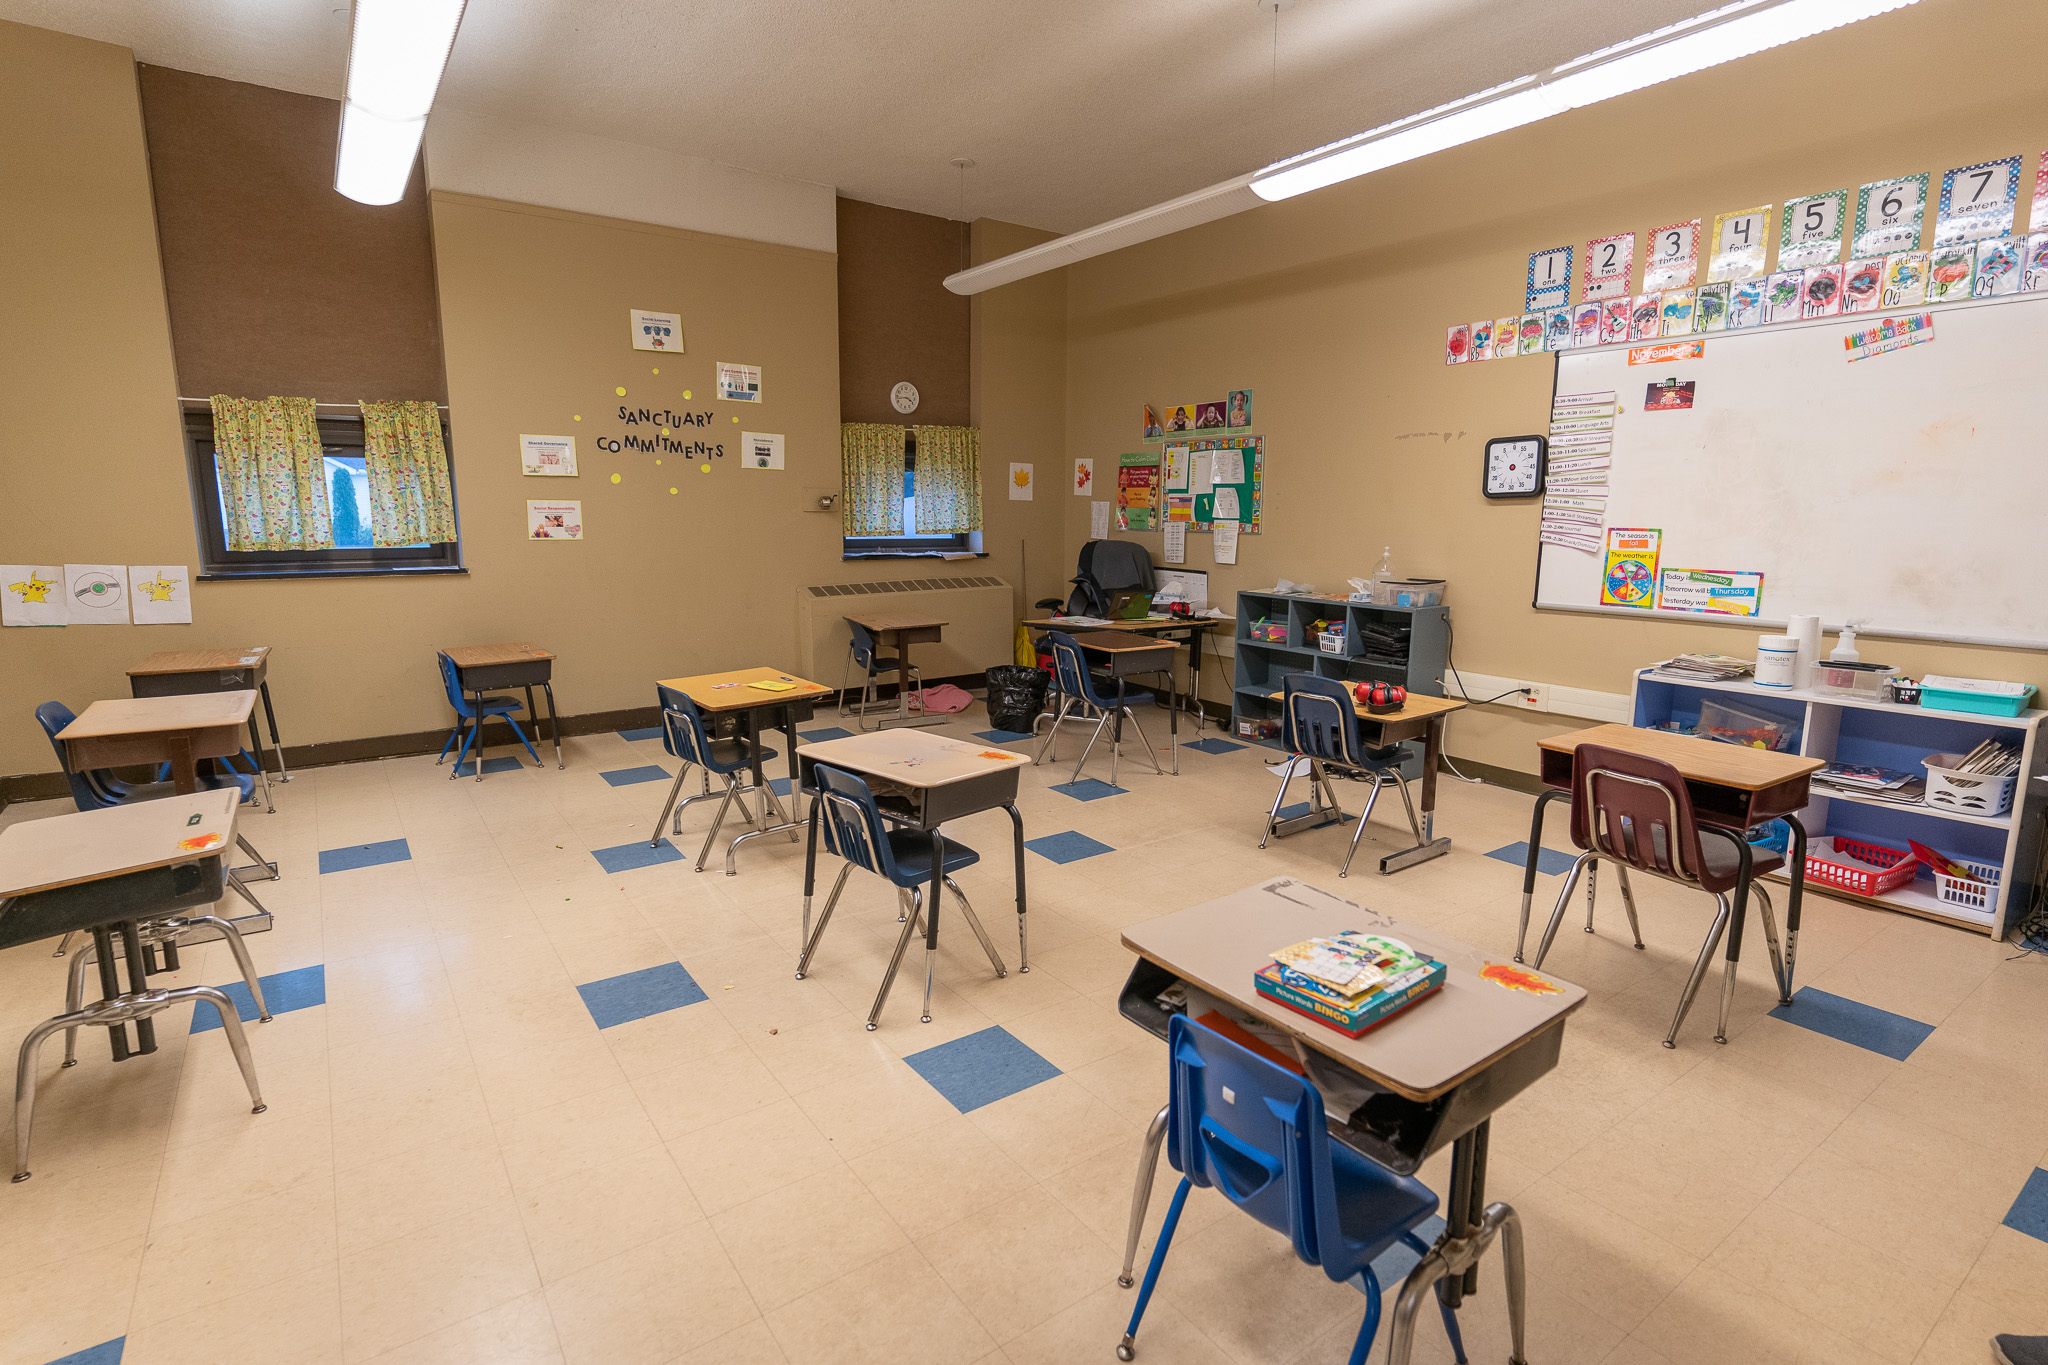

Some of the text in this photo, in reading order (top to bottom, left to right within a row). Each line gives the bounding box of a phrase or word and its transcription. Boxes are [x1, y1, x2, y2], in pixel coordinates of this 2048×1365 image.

[1969, 170, 1994, 203] 7
[1881, 186, 1903, 217] 6
[1957, 200, 1998, 214] seven
[1804, 201, 1826, 231] 5
[1881, 216, 1899, 226] six
[1733, 218, 1751, 244] 4
[1802, 230, 1824, 240] five
[1664, 231, 1681, 257] 3
[1728, 243, 1752, 253] four
[1602, 243, 1617, 268] 2
[1658, 254, 1686, 265] three
[1895, 253, 1929, 267] octopus
[1547, 256, 1553, 280] 1
[1600, 267, 1618, 275] two
[1865, 258, 1886, 271] nest
[1542, 278, 1557, 286] one
[1974, 275, 1995, 296] Qq
[2023, 270, 2041, 291] Rr
[1701, 283, 1729, 295] jellyfish
[1930, 281, 1948, 301] Pp
[1841, 294, 1859, 313] Nn
[1883, 288, 1901, 307] Oo
[1802, 300, 1825, 317] Mm
[1630, 322, 1642, 340] Hh
[1661, 320, 1670, 336] Ii
[1862, 333, 1919, 356] Diamonds
[1446, 350, 1457, 365] Aa
[1471, 346, 1480, 361] Bb
[1631, 346, 1687, 360] November
[618, 406, 714, 429] SANCTUARY
[596, 434, 724, 460] COMMITMENTS
[1577, 514, 1599, 522] Streaming
[1665, 573, 1685, 582] Today
[1692, 572, 1730, 585] Wednesday
[1665, 585, 1694, 593] Tomorrow
[1714, 588, 1750, 596] Thursday
[1663, 597, 1694, 606] Yesterday
[1407, 979, 1430, 999] BINGO
[1276, 986, 1295, 1001] Picture
[1295, 995, 1313, 1009] Words
[1314, 1002, 1350, 1025] BINGO
